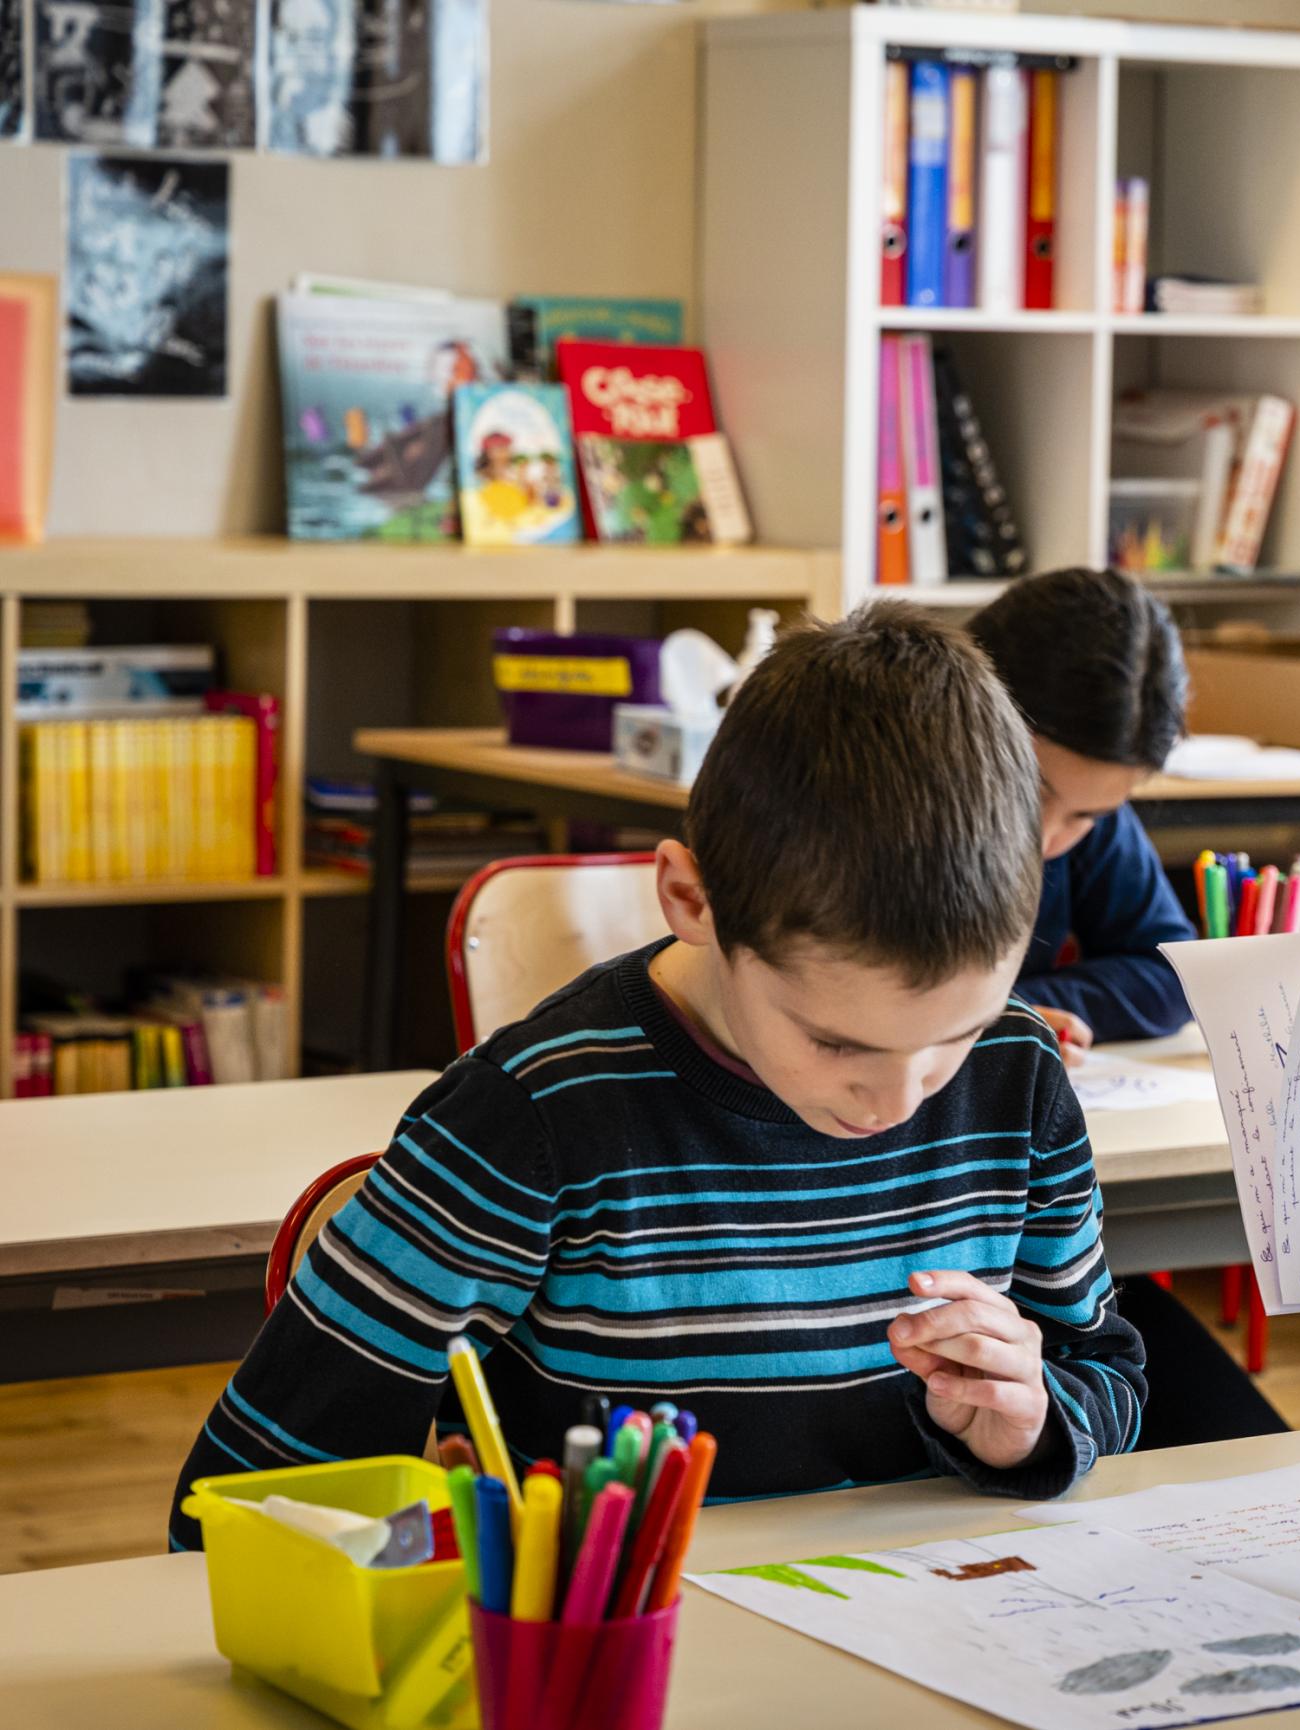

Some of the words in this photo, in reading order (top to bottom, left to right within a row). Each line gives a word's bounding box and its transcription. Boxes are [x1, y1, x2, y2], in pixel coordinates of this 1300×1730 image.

[1230, 1031, 1255, 1112] confinement
[1230, 1090, 1250, 1154] manqué
[1257, 1210, 1272, 1234] qui
